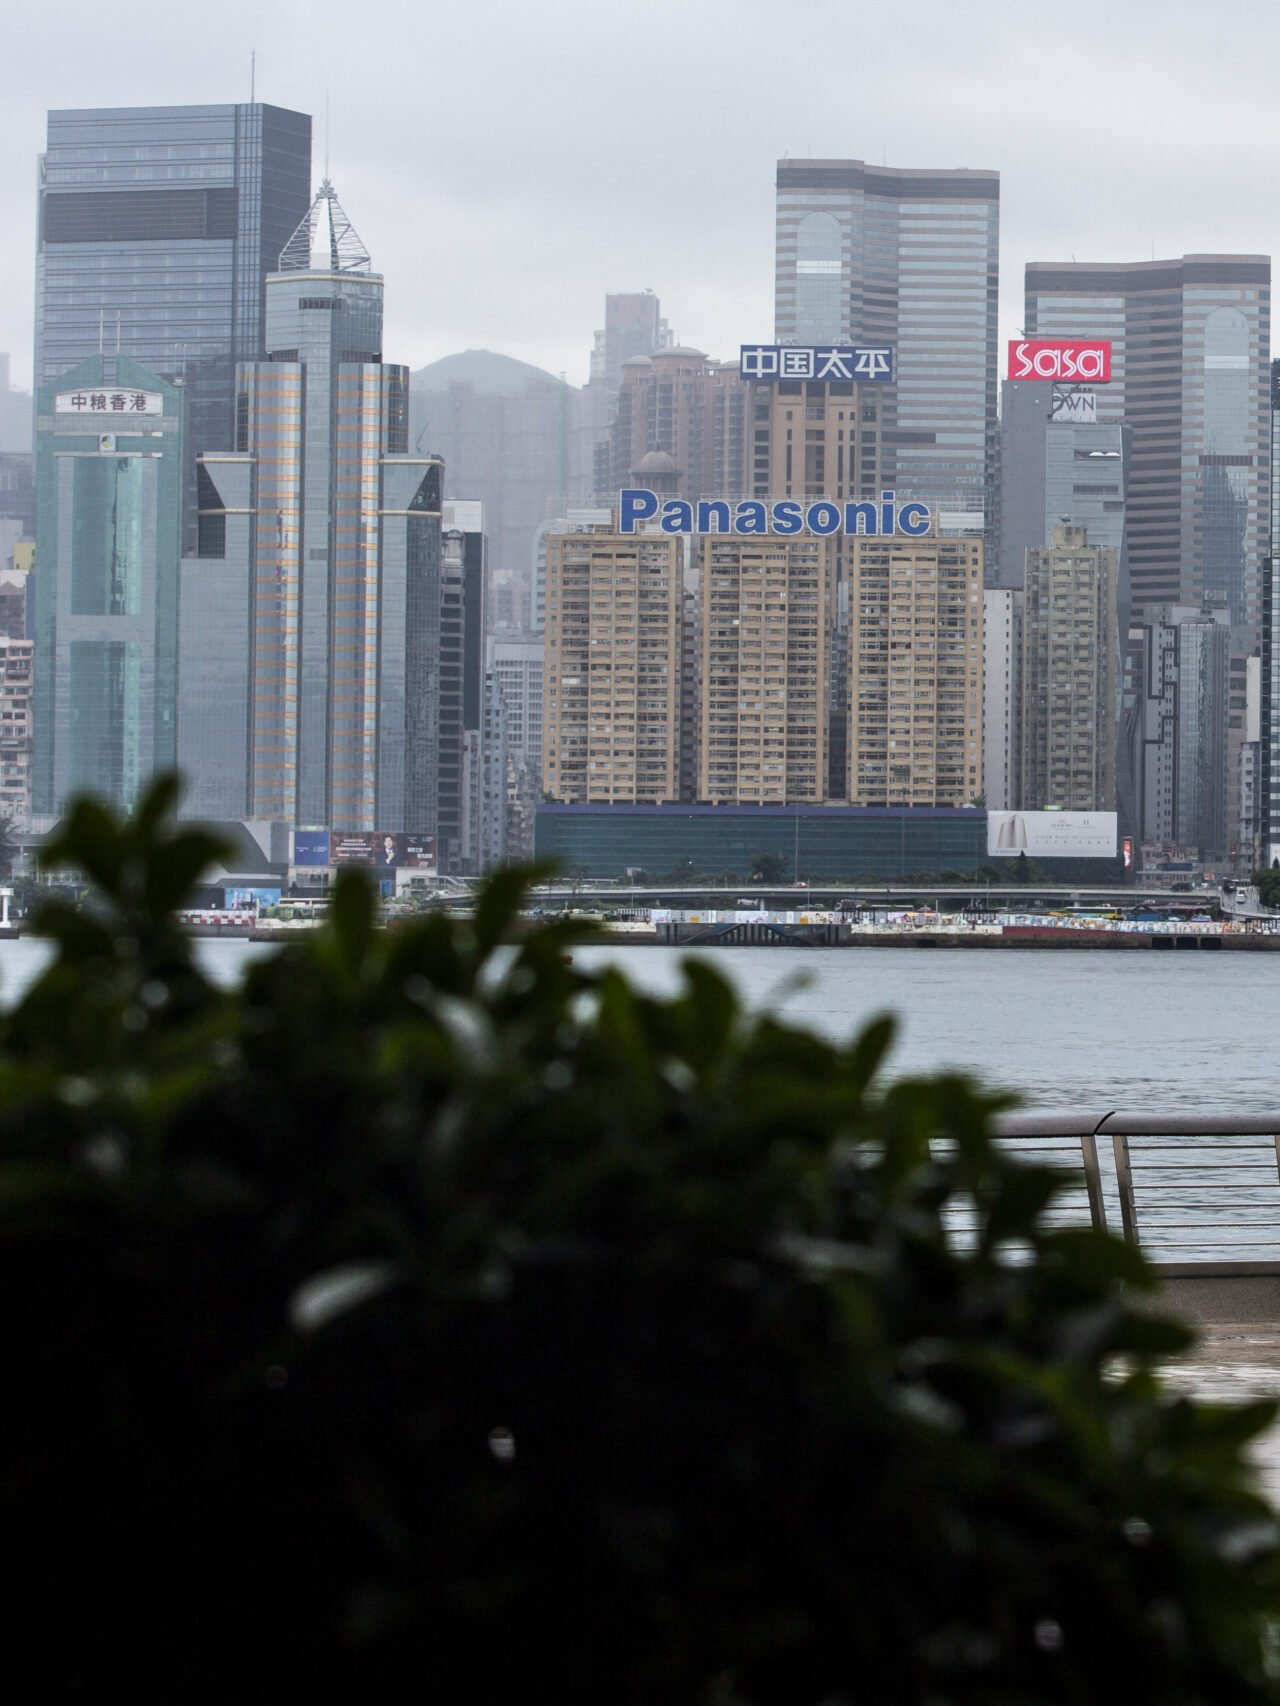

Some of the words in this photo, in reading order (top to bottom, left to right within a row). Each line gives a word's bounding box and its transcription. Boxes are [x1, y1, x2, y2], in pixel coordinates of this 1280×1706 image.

[742, 347, 890, 379] 中国太平
[71, 393, 147, 411] 中粮香港
[619, 488, 932, 537] Panasonic
